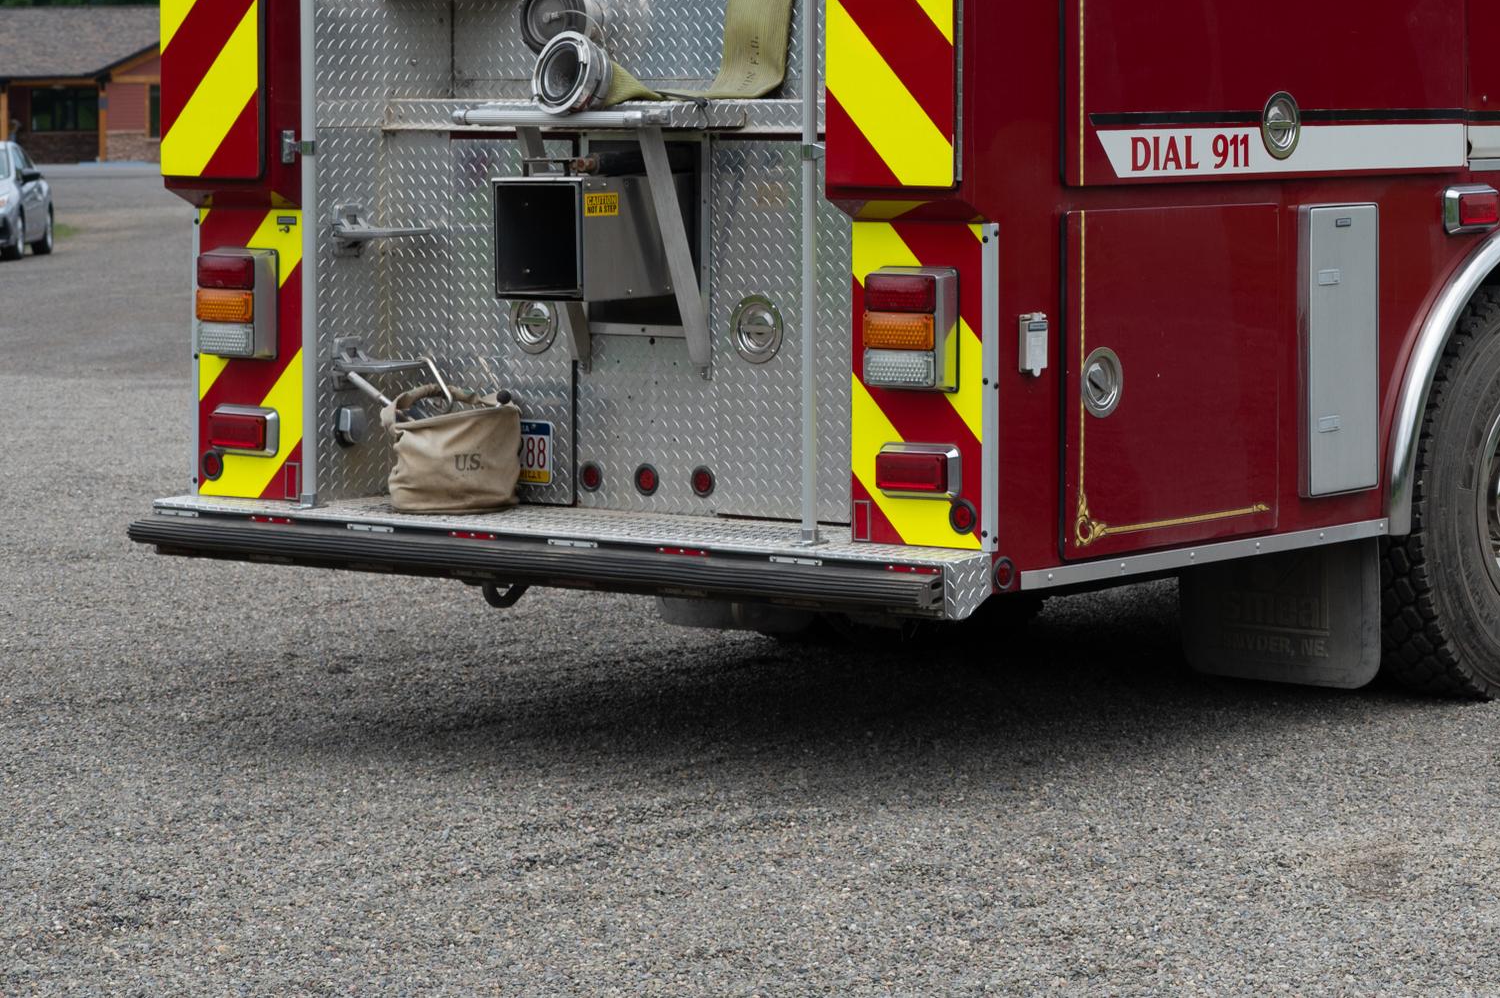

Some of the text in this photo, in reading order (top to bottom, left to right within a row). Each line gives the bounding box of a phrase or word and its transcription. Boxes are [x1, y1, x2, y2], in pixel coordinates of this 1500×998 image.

[1130, 133, 1250, 171] DIAL 911
[586, 195, 617, 205] CAUTION
[587, 205, 598, 213] NOT
[604, 204, 617, 213] STEP
[454, 453, 485, 471] U.S.
